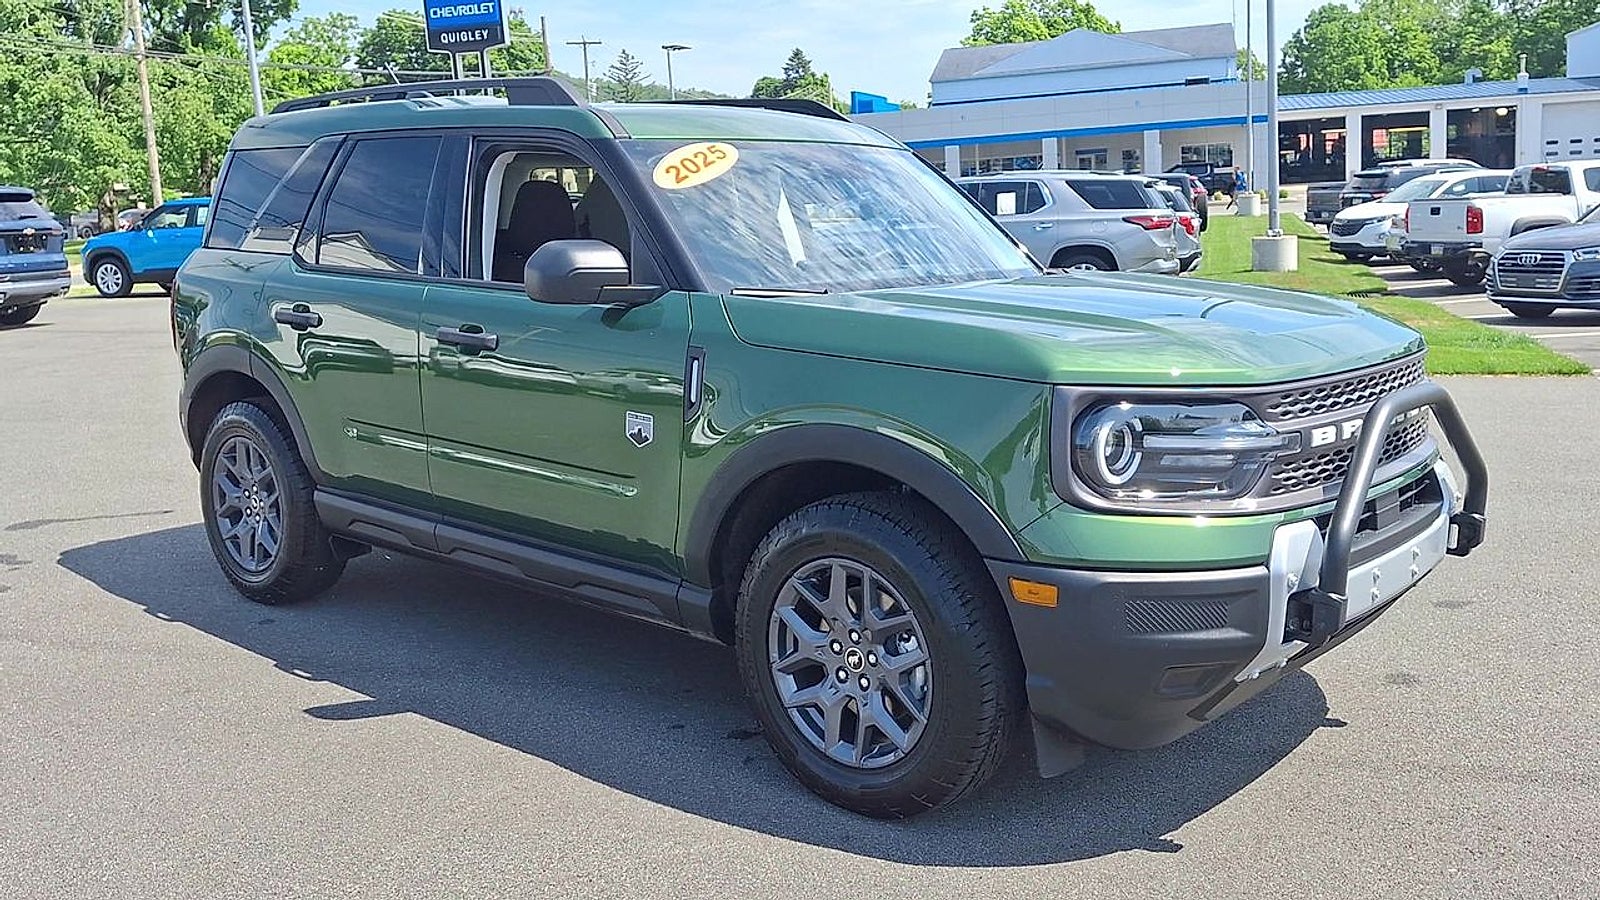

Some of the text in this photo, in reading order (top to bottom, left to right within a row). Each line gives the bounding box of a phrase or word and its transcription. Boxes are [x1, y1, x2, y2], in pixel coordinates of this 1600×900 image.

[430, 2, 495, 19] CHEVROLET
[440, 29, 489, 44] QUIGLEY
[665, 144, 727, 184] 2025
